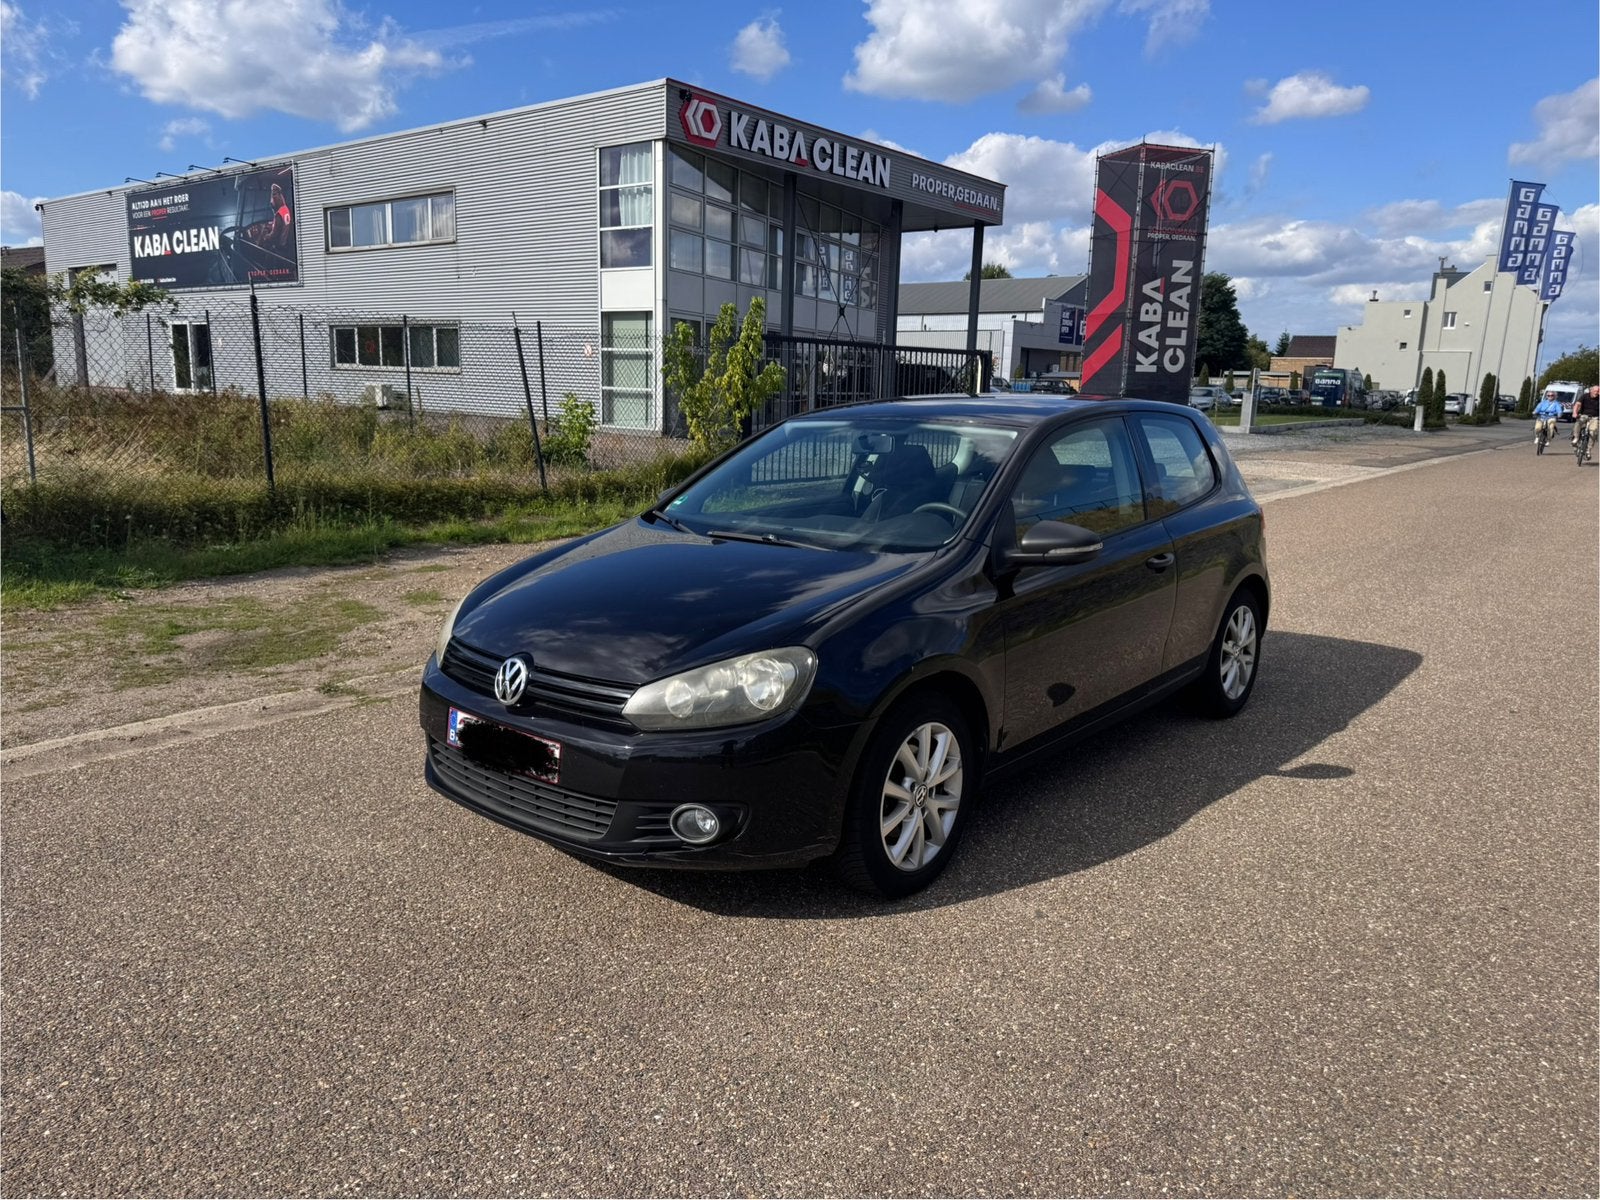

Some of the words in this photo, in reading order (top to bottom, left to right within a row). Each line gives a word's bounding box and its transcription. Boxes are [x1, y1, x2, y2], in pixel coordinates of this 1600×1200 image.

[730, 111, 809, 166] KABA
[812, 138, 890, 188] CLEAN
[131, 200, 150, 210] ALTIJD
[162, 196, 173, 205] HET
[174, 193, 189, 204] ROER
[132, 211, 143, 219] VOOR
[134, 233, 172, 258] KABA
[172, 226, 219, 254] CLEAN
[1135, 277, 1165, 373] KABA
[1163, 259, 1194, 373] CLEAN
[449, 729, 455, 740] B
